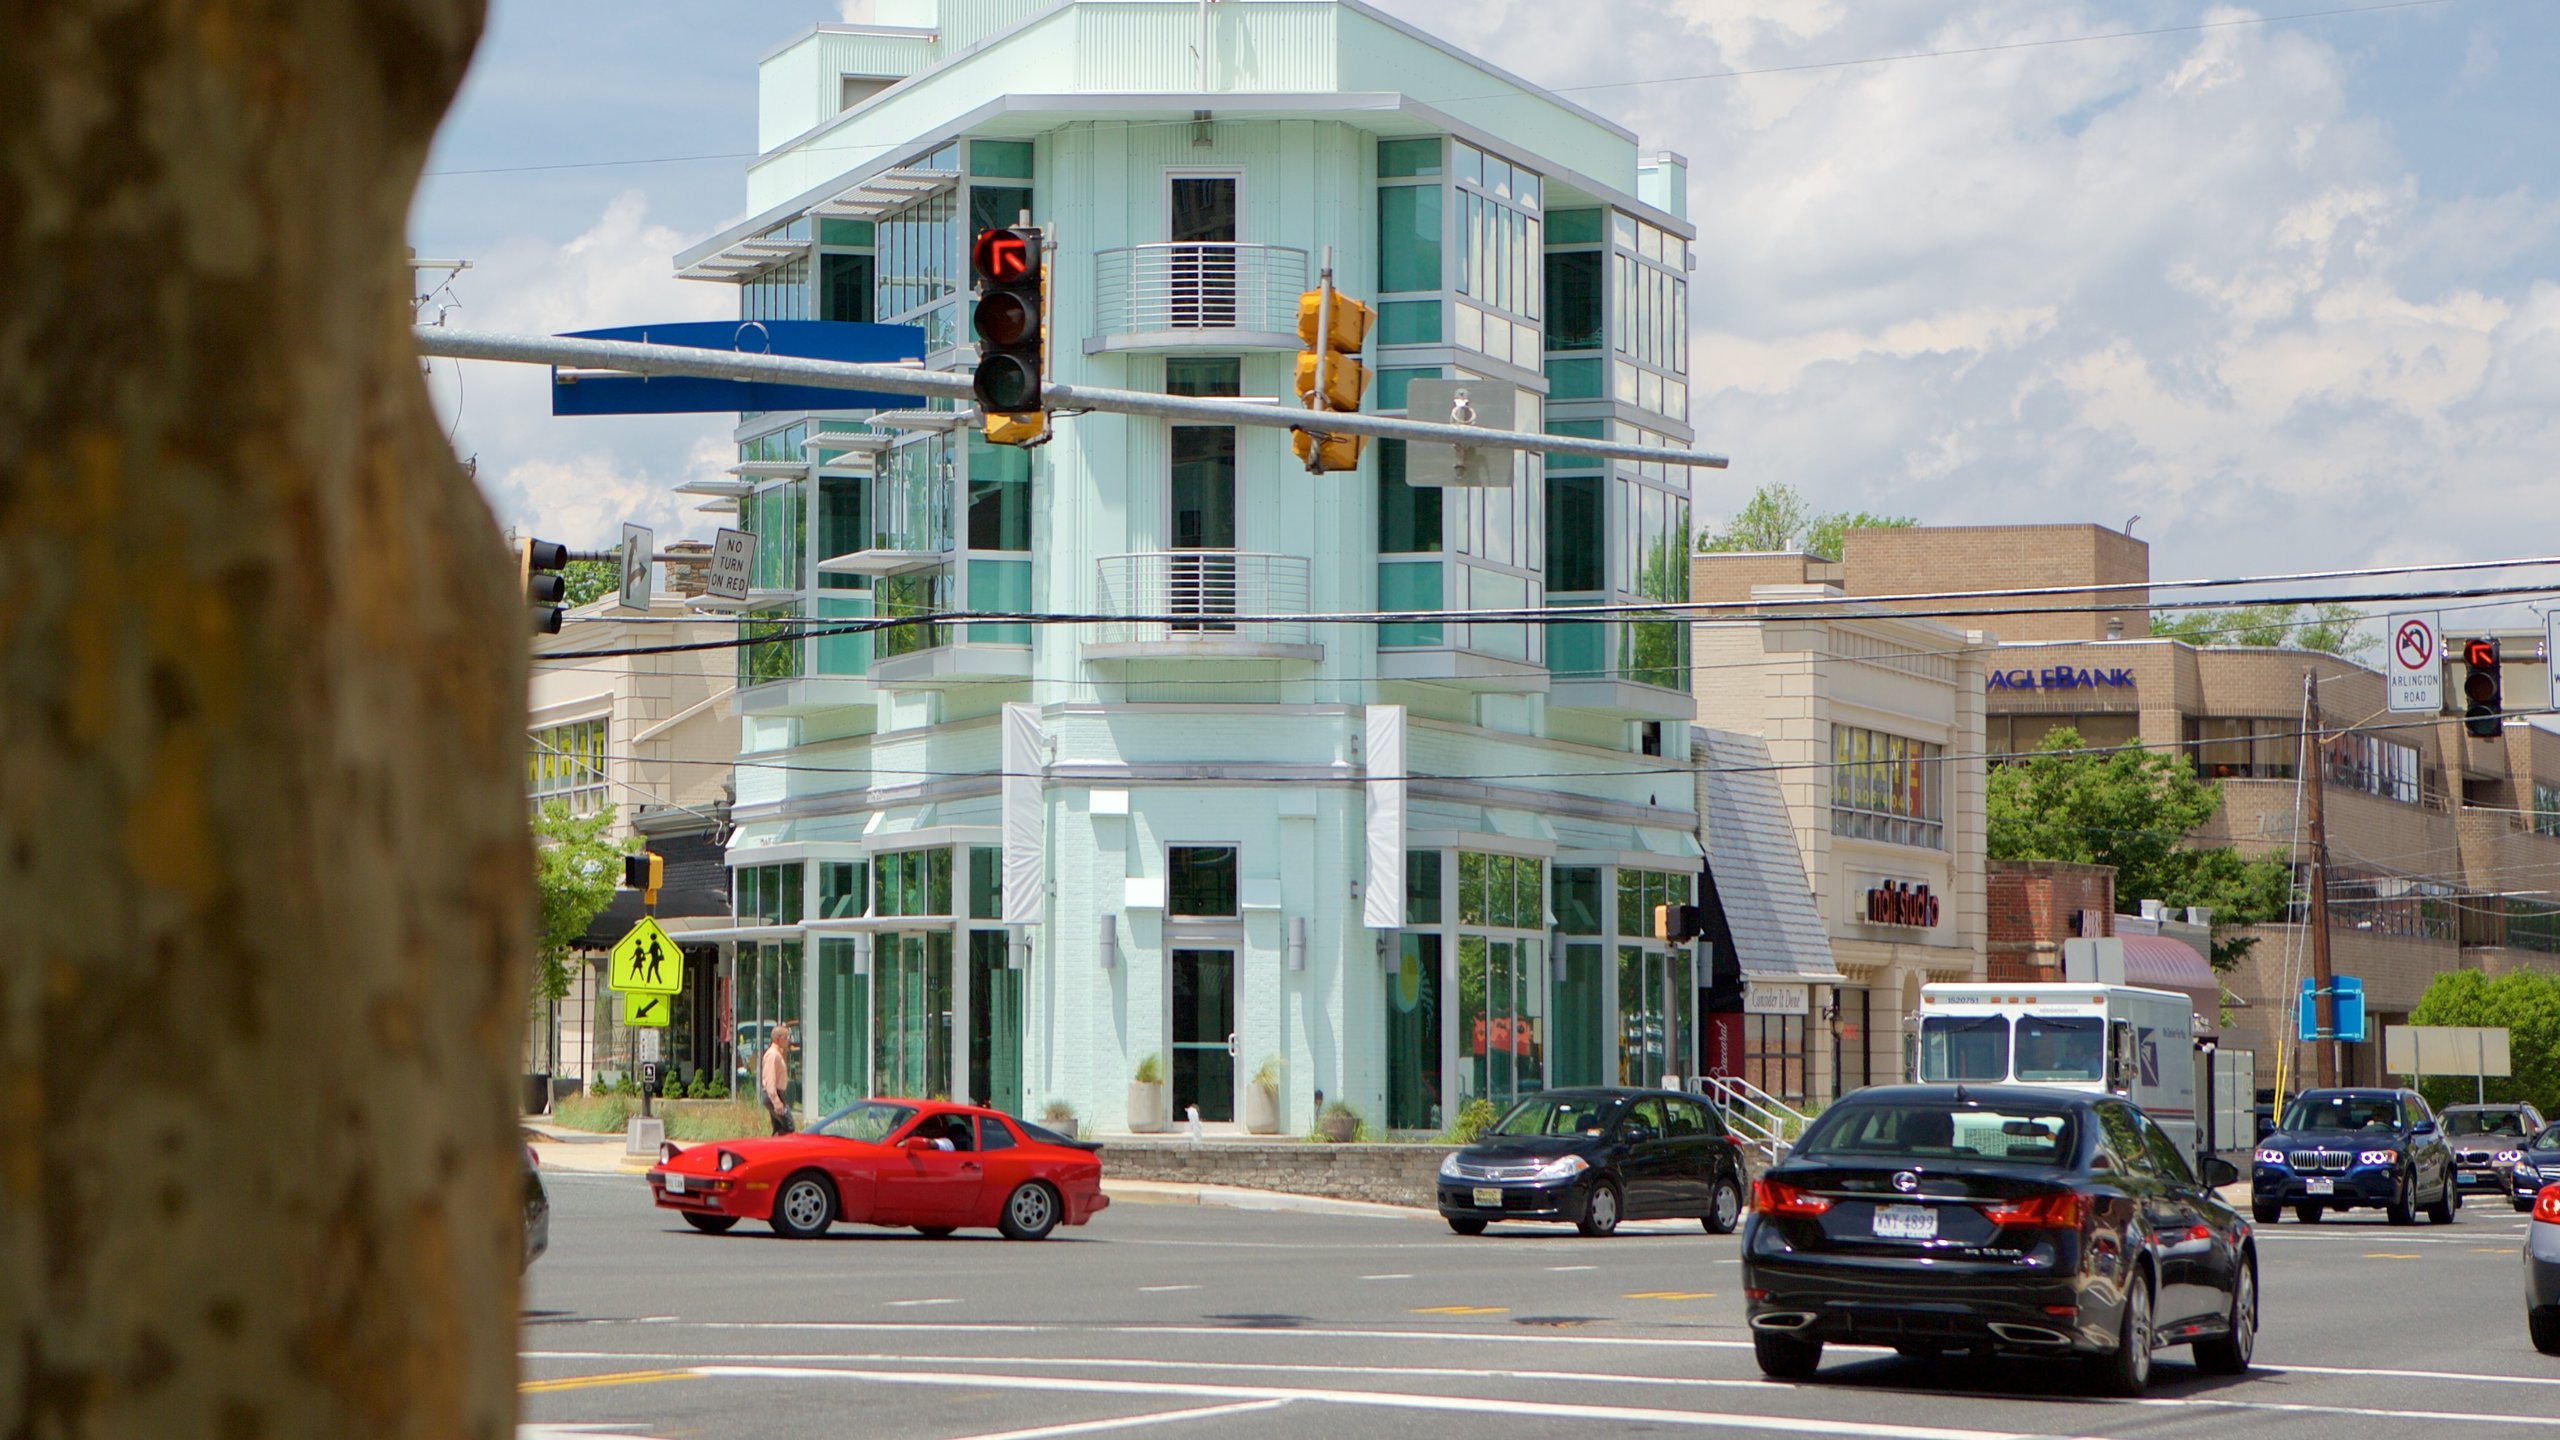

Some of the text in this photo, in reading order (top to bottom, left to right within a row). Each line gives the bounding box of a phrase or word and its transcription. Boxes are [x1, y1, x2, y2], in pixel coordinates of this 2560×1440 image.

[727, 538, 743, 553] NO
[719, 556, 744, 573] TURN
[711, 574, 745, 592] ON RED
[2391, 674, 2438, 688] ARLINGTON
[2403, 691, 2426, 703] ROAD
[1868, 880, 1896, 923] nail
